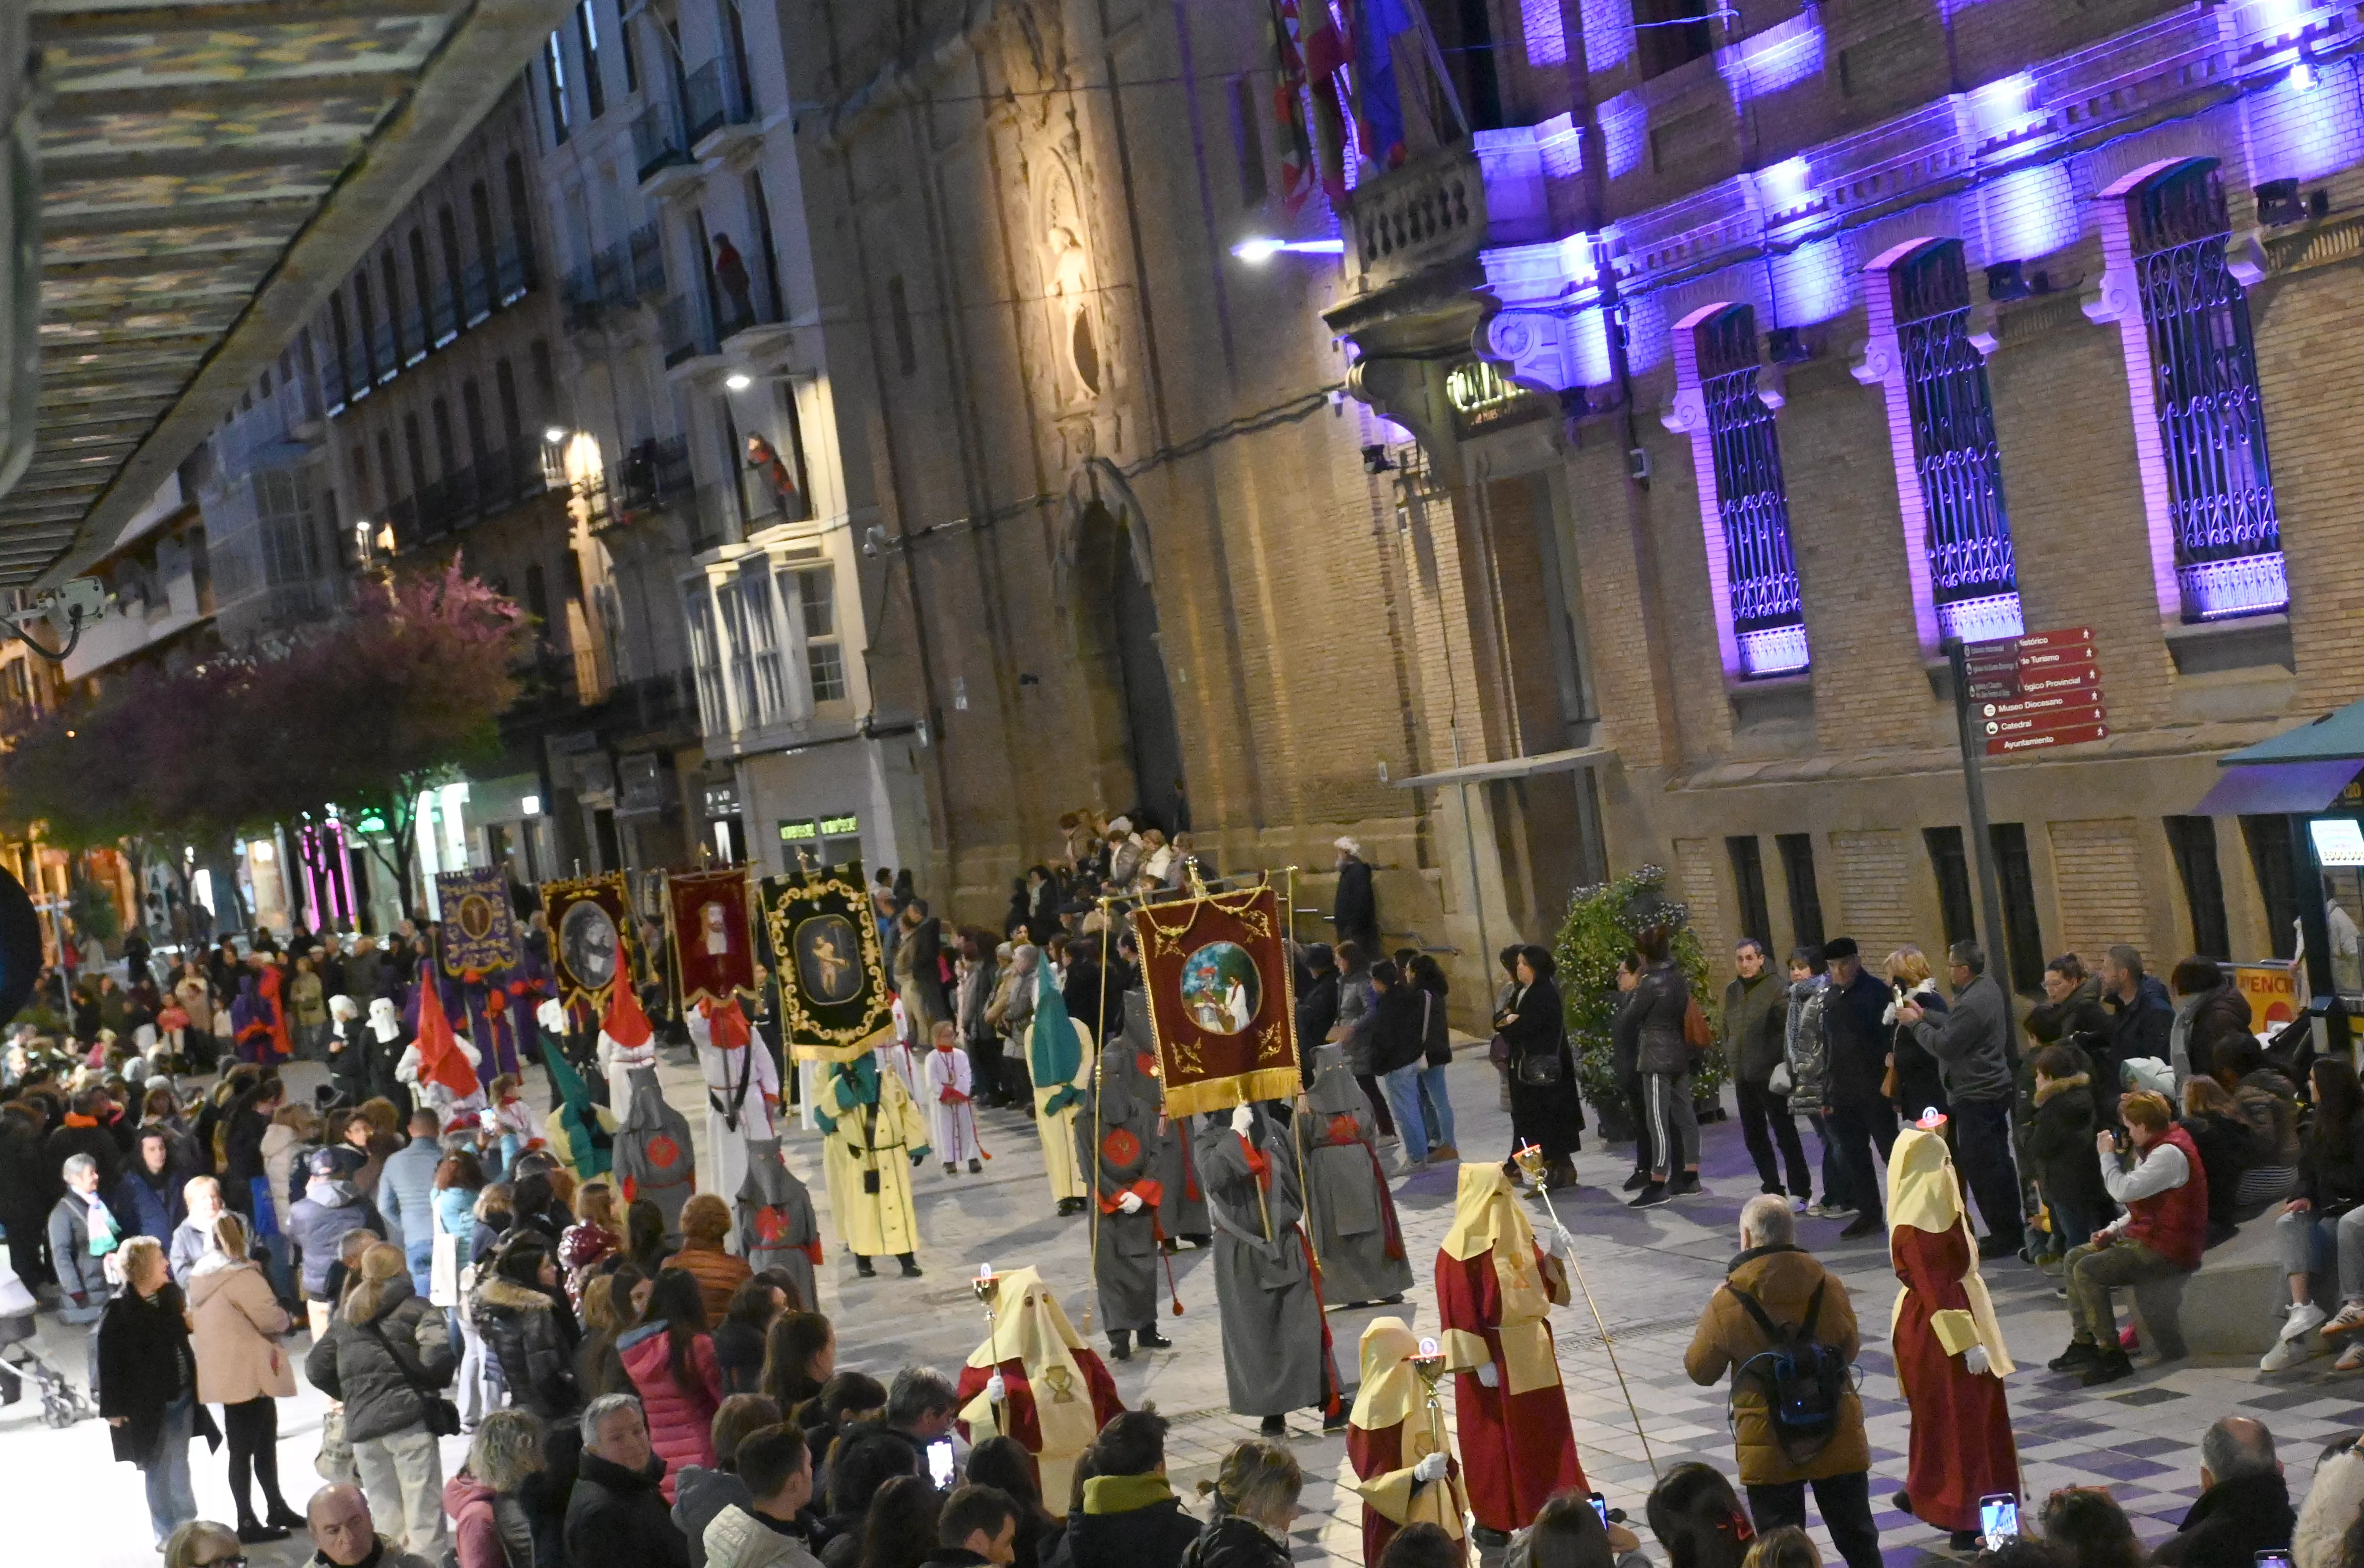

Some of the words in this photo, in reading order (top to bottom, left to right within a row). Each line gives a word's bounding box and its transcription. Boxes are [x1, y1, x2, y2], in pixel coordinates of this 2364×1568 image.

[2031, 654, 2060, 663] Turismo
[2045, 676, 2081, 688] Provincial
[1998, 703, 2024, 713] Museo
[2024, 698, 2063, 709] Diocesano
[2001, 719, 2032, 730] Catedral
[2004, 736, 2054, 750] Ayuntamiento
